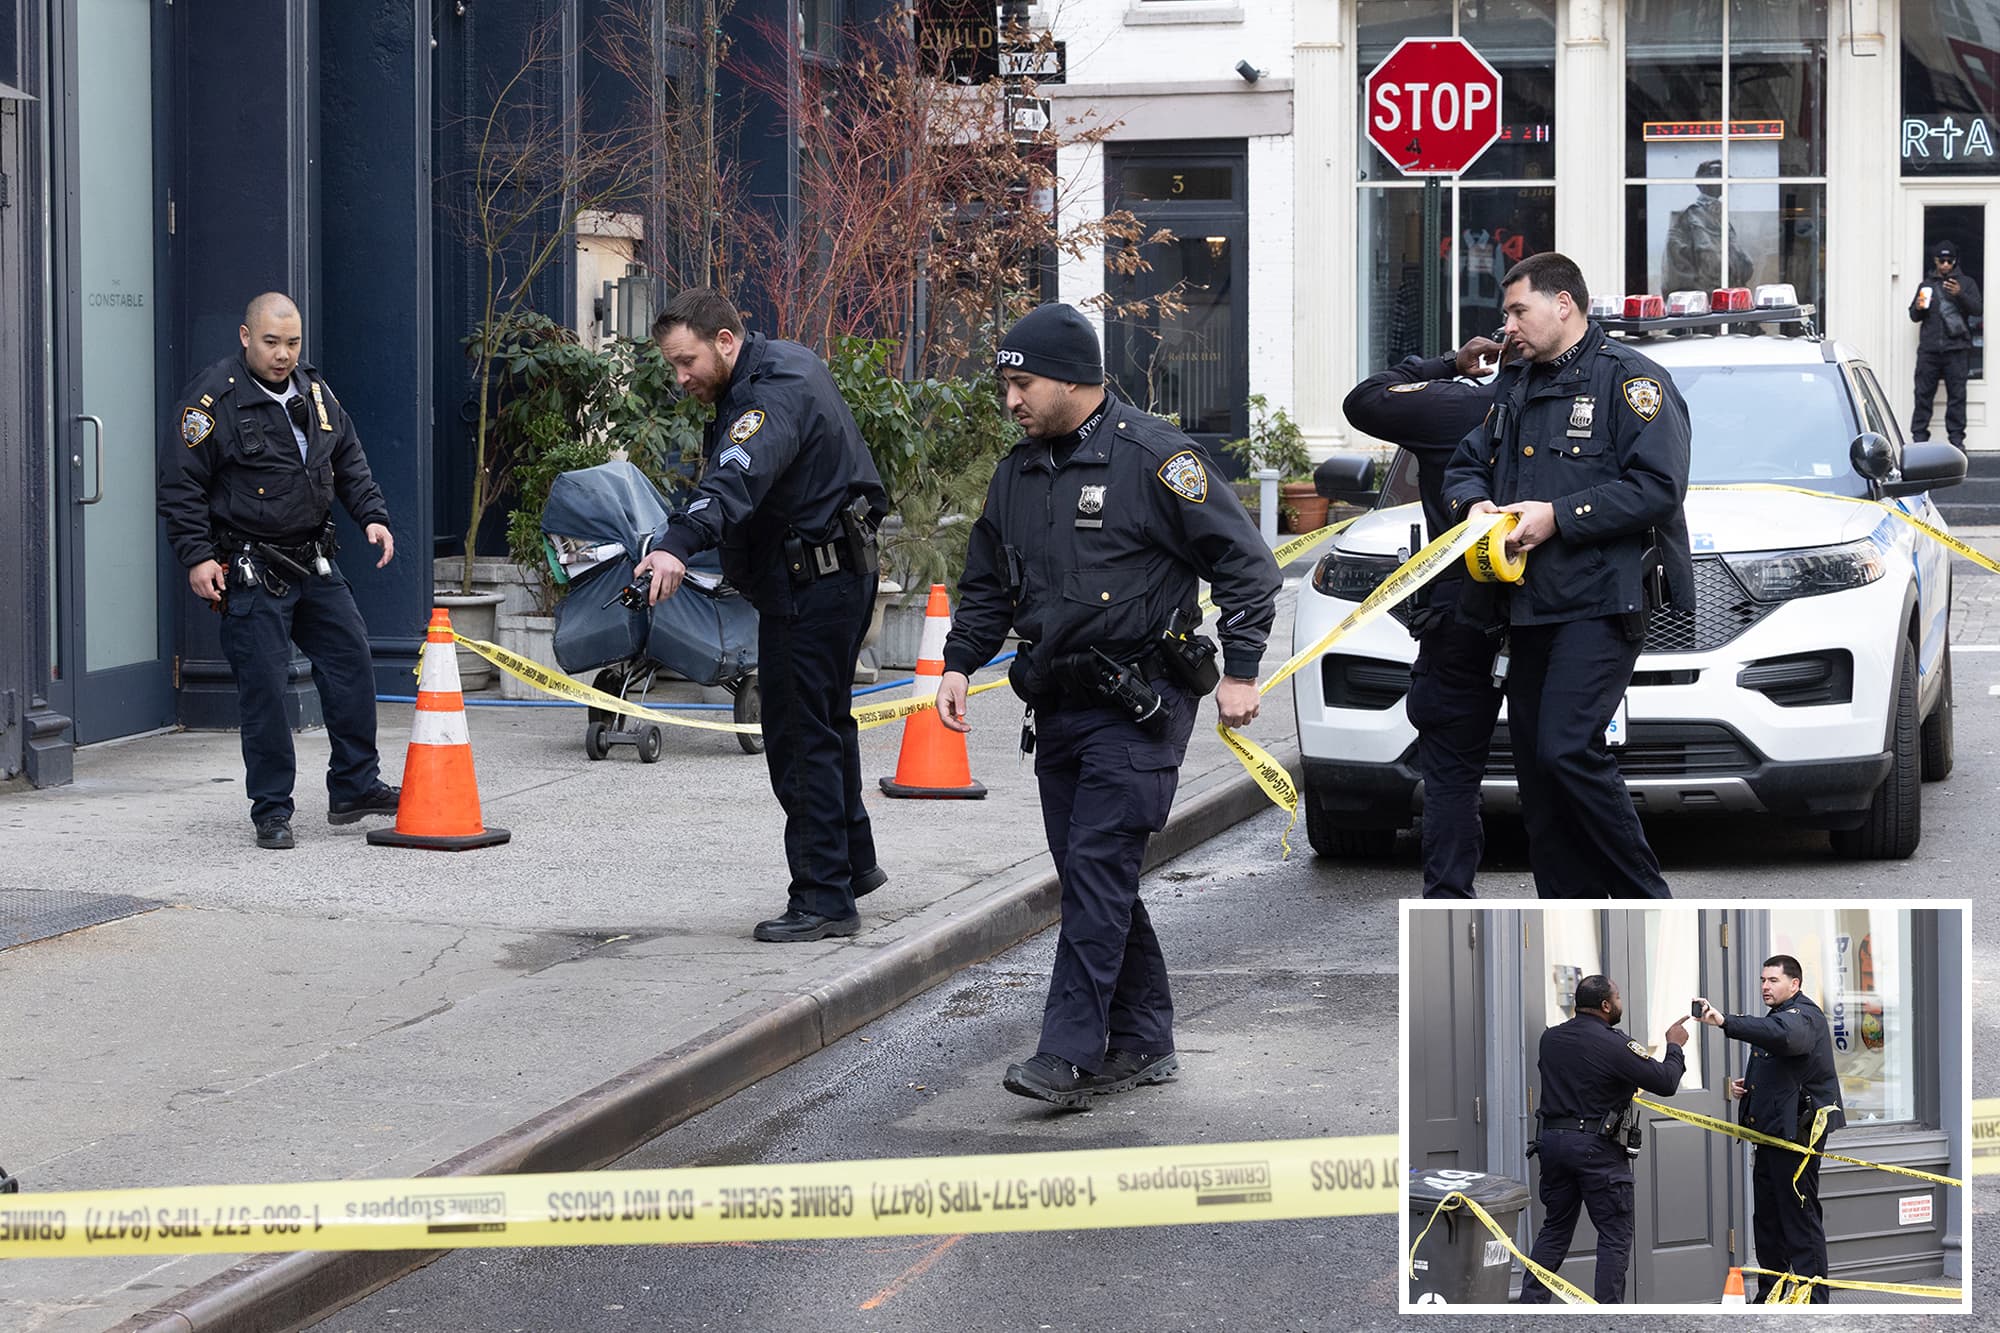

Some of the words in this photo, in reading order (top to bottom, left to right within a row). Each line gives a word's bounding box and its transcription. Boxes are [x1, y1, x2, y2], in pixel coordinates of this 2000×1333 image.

[1374, 82, 1492, 131] STOP
[1171, 175, 1185, 193] 3
[88, 294, 144, 307] CONSTABLE
[1078, 414, 1102, 440] NYPD
[1310, 1158, 1375, 1192] CROSS
[548, 1191, 613, 1222] CROSS
[621, 1190, 660, 1221] NOT
[668, 1189, 695, 1220] DO
[719, 1186, 784, 1220] SCENE
[790, 1185, 854, 1219] CRIME
[872, 1180, 933, 1220] (8477)
[940, 1176, 1097, 1214] 1-800-577-TIPS
[0, 1210, 66, 1240] CRIME
[85, 1207, 150, 1242] (8477)
[158, 1204, 323, 1238] 1-800-577-TIPS
